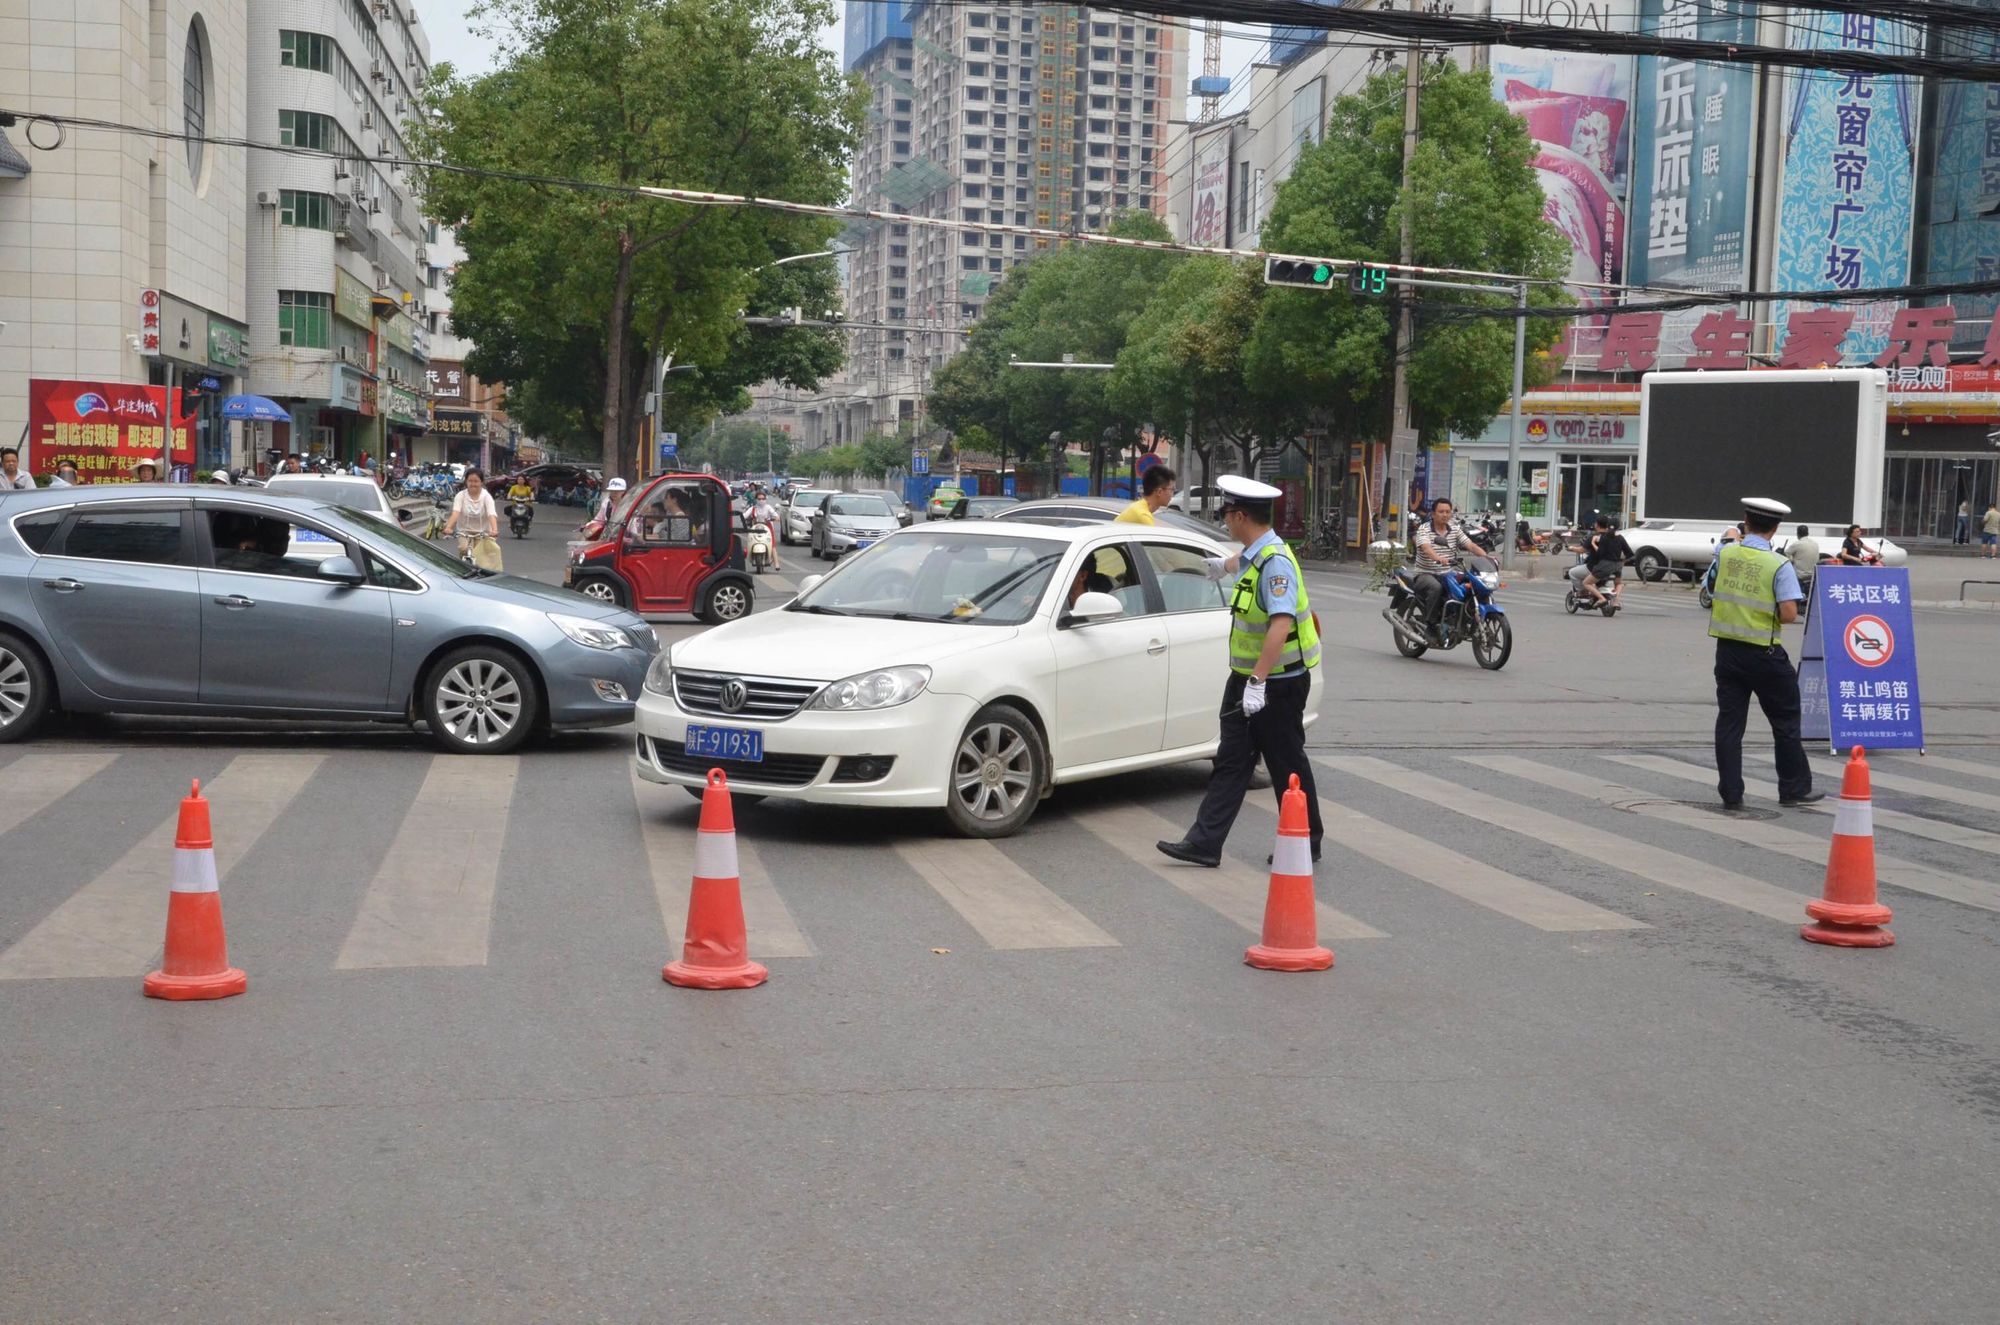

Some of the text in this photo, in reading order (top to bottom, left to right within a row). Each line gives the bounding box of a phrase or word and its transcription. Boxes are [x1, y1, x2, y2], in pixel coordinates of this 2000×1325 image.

[1361, 268, 1385, 293] 19
[1549, 305, 2000, 371] 民生家乐
[426, 370, 460, 384] 托管
[1727, 558, 1763, 582] 警察
[1723, 578, 1760, 594] POLICE
[1828, 584, 1901, 604] 考试区域
[1839, 680, 1908, 699] 禁止鸣笛
[1842, 702, 1911, 721] 车辆缓行
